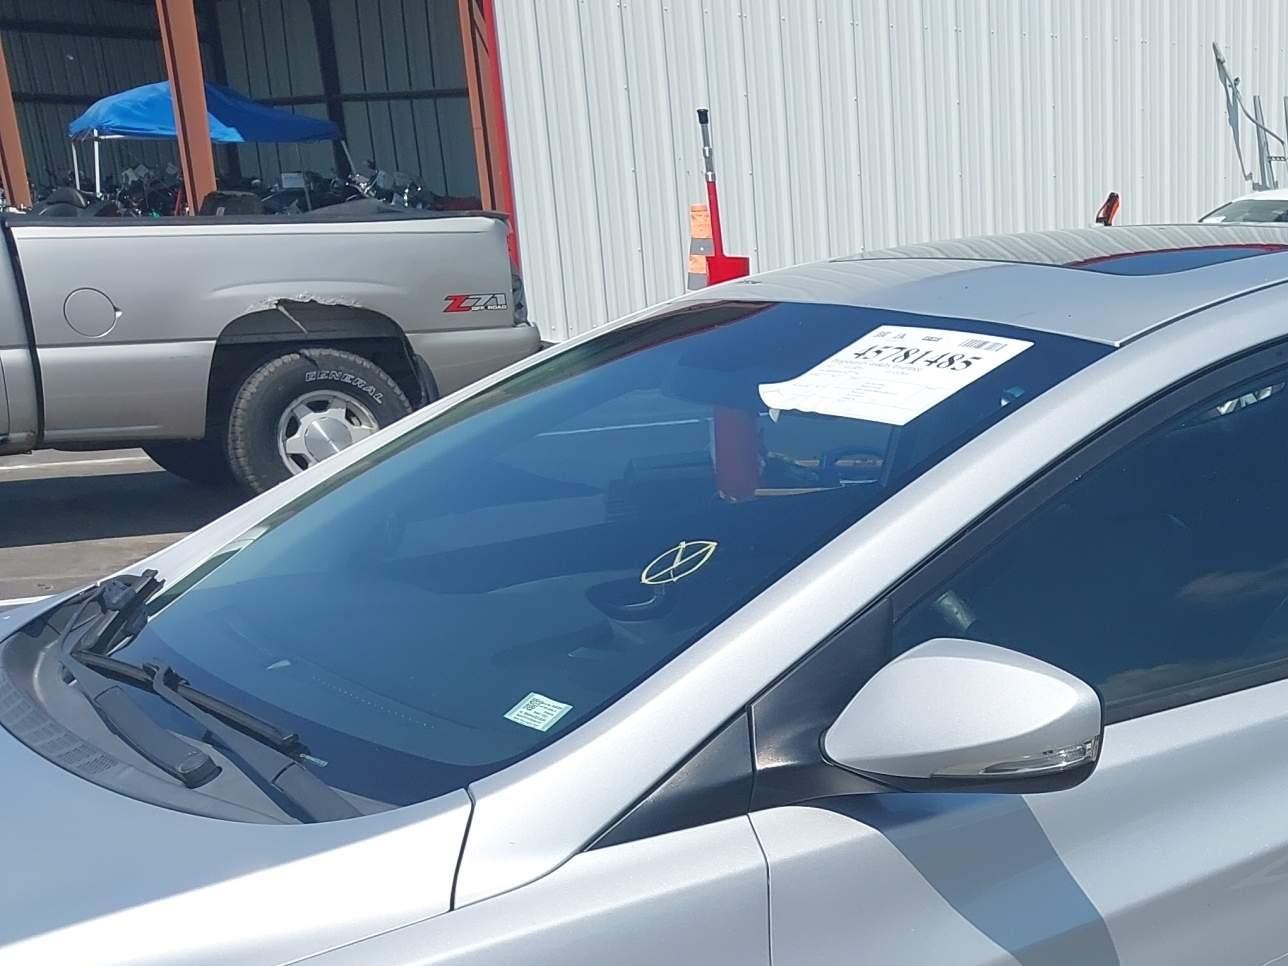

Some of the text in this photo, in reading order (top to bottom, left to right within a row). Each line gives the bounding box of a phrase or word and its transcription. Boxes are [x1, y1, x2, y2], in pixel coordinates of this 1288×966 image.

[443, 293, 507, 312] Z71
[854, 345, 983, 371] 45781485
[305, 370, 384, 404] GENERAL
